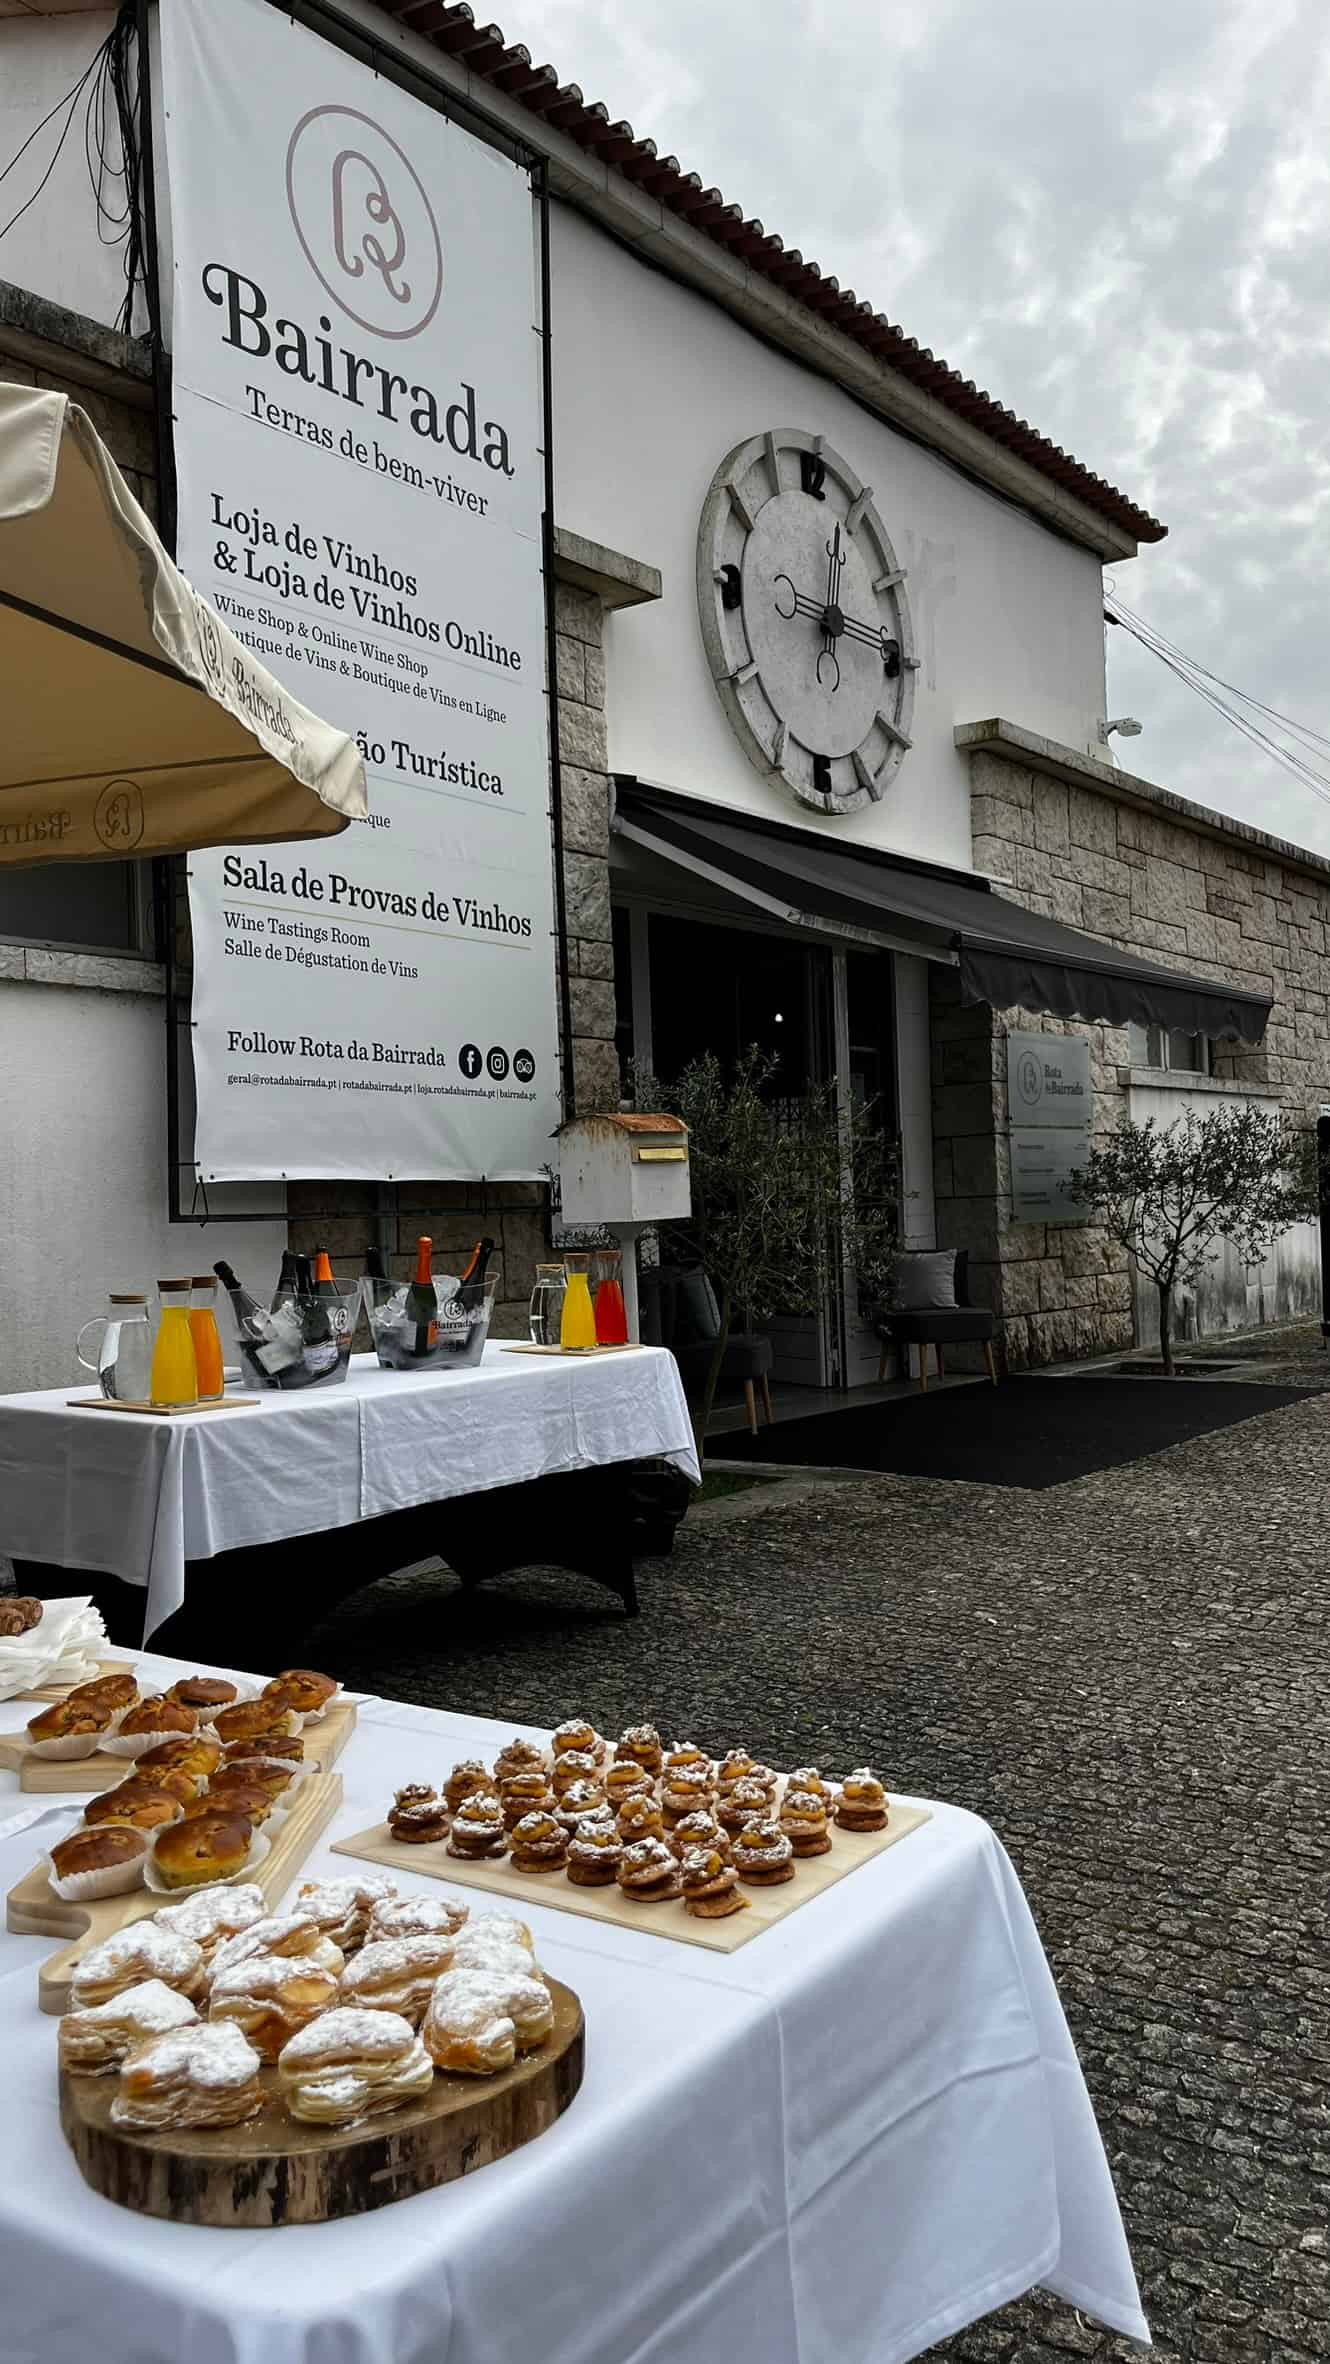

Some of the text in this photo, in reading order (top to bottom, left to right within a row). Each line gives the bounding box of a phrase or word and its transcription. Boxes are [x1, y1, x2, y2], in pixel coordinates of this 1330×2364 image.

[202, 263, 515, 477] Bairrada
[246, 384, 489, 517] Terras de bem-viver
[210, 493, 418, 597] Loja de Vinhos
[213, 540, 522, 671] & Loja de Vinhos Online
[213, 592, 429, 680] Wine Shop & Online Wine Shop
[231, 629, 507, 726] utique de Vins & Boutique de Vins en Ligne
[231, 657, 297, 744] Bairrada
[391, 740, 504, 797] Turística
[223, 855, 532, 937] Sala de Provas de Vinhos
[223, 911, 371, 948] Wine Tastings Room
[224, 938, 418, 979] Salle de Dégustation de Vins
[227, 1031, 446, 1066] Follow Rota da Bairrada
[227, 1073, 337, 1090] geral@rotadabairrada.pt
[342, 1079, 413, 1094] rotadabairrada.pt
